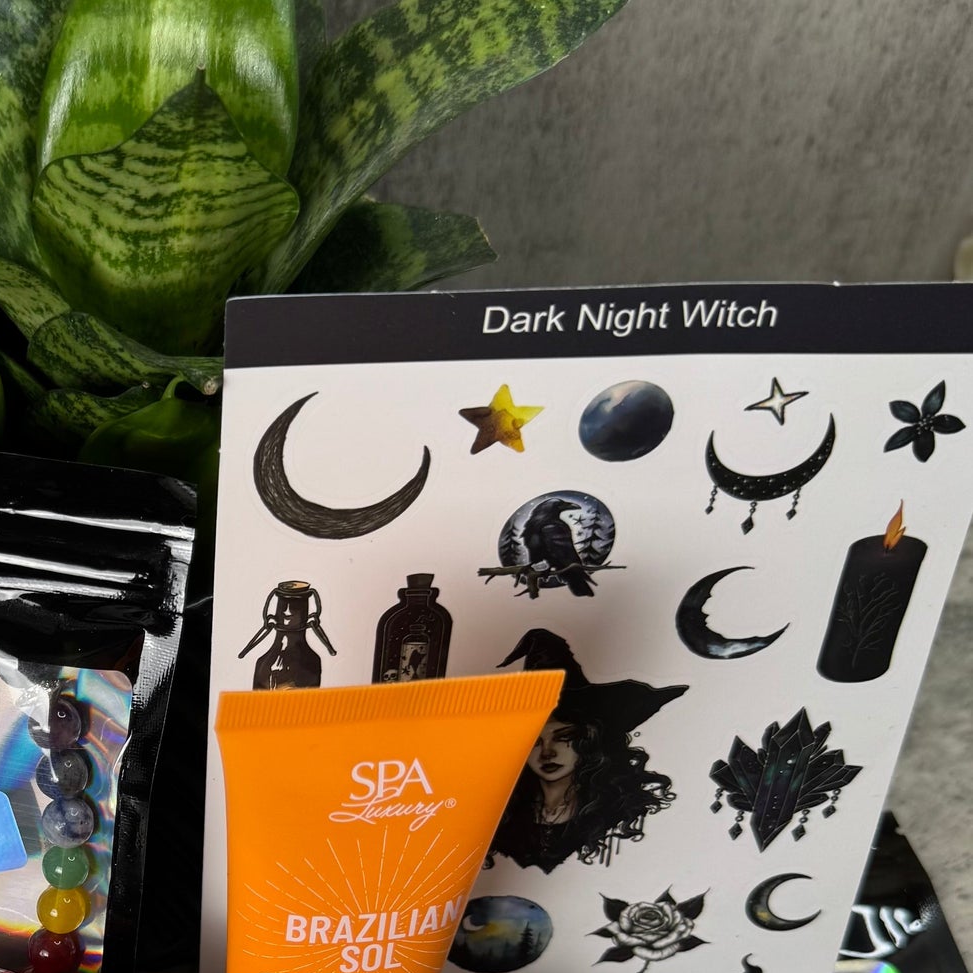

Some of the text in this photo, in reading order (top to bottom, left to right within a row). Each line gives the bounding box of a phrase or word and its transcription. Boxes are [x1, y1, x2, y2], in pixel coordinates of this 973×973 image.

[482, 299, 778, 337] Dark Night Witch
[349, 757, 433, 801] SPA
[285, 895, 464, 944] BRAZILIAN
[339, 942, 402, 973] SOL
